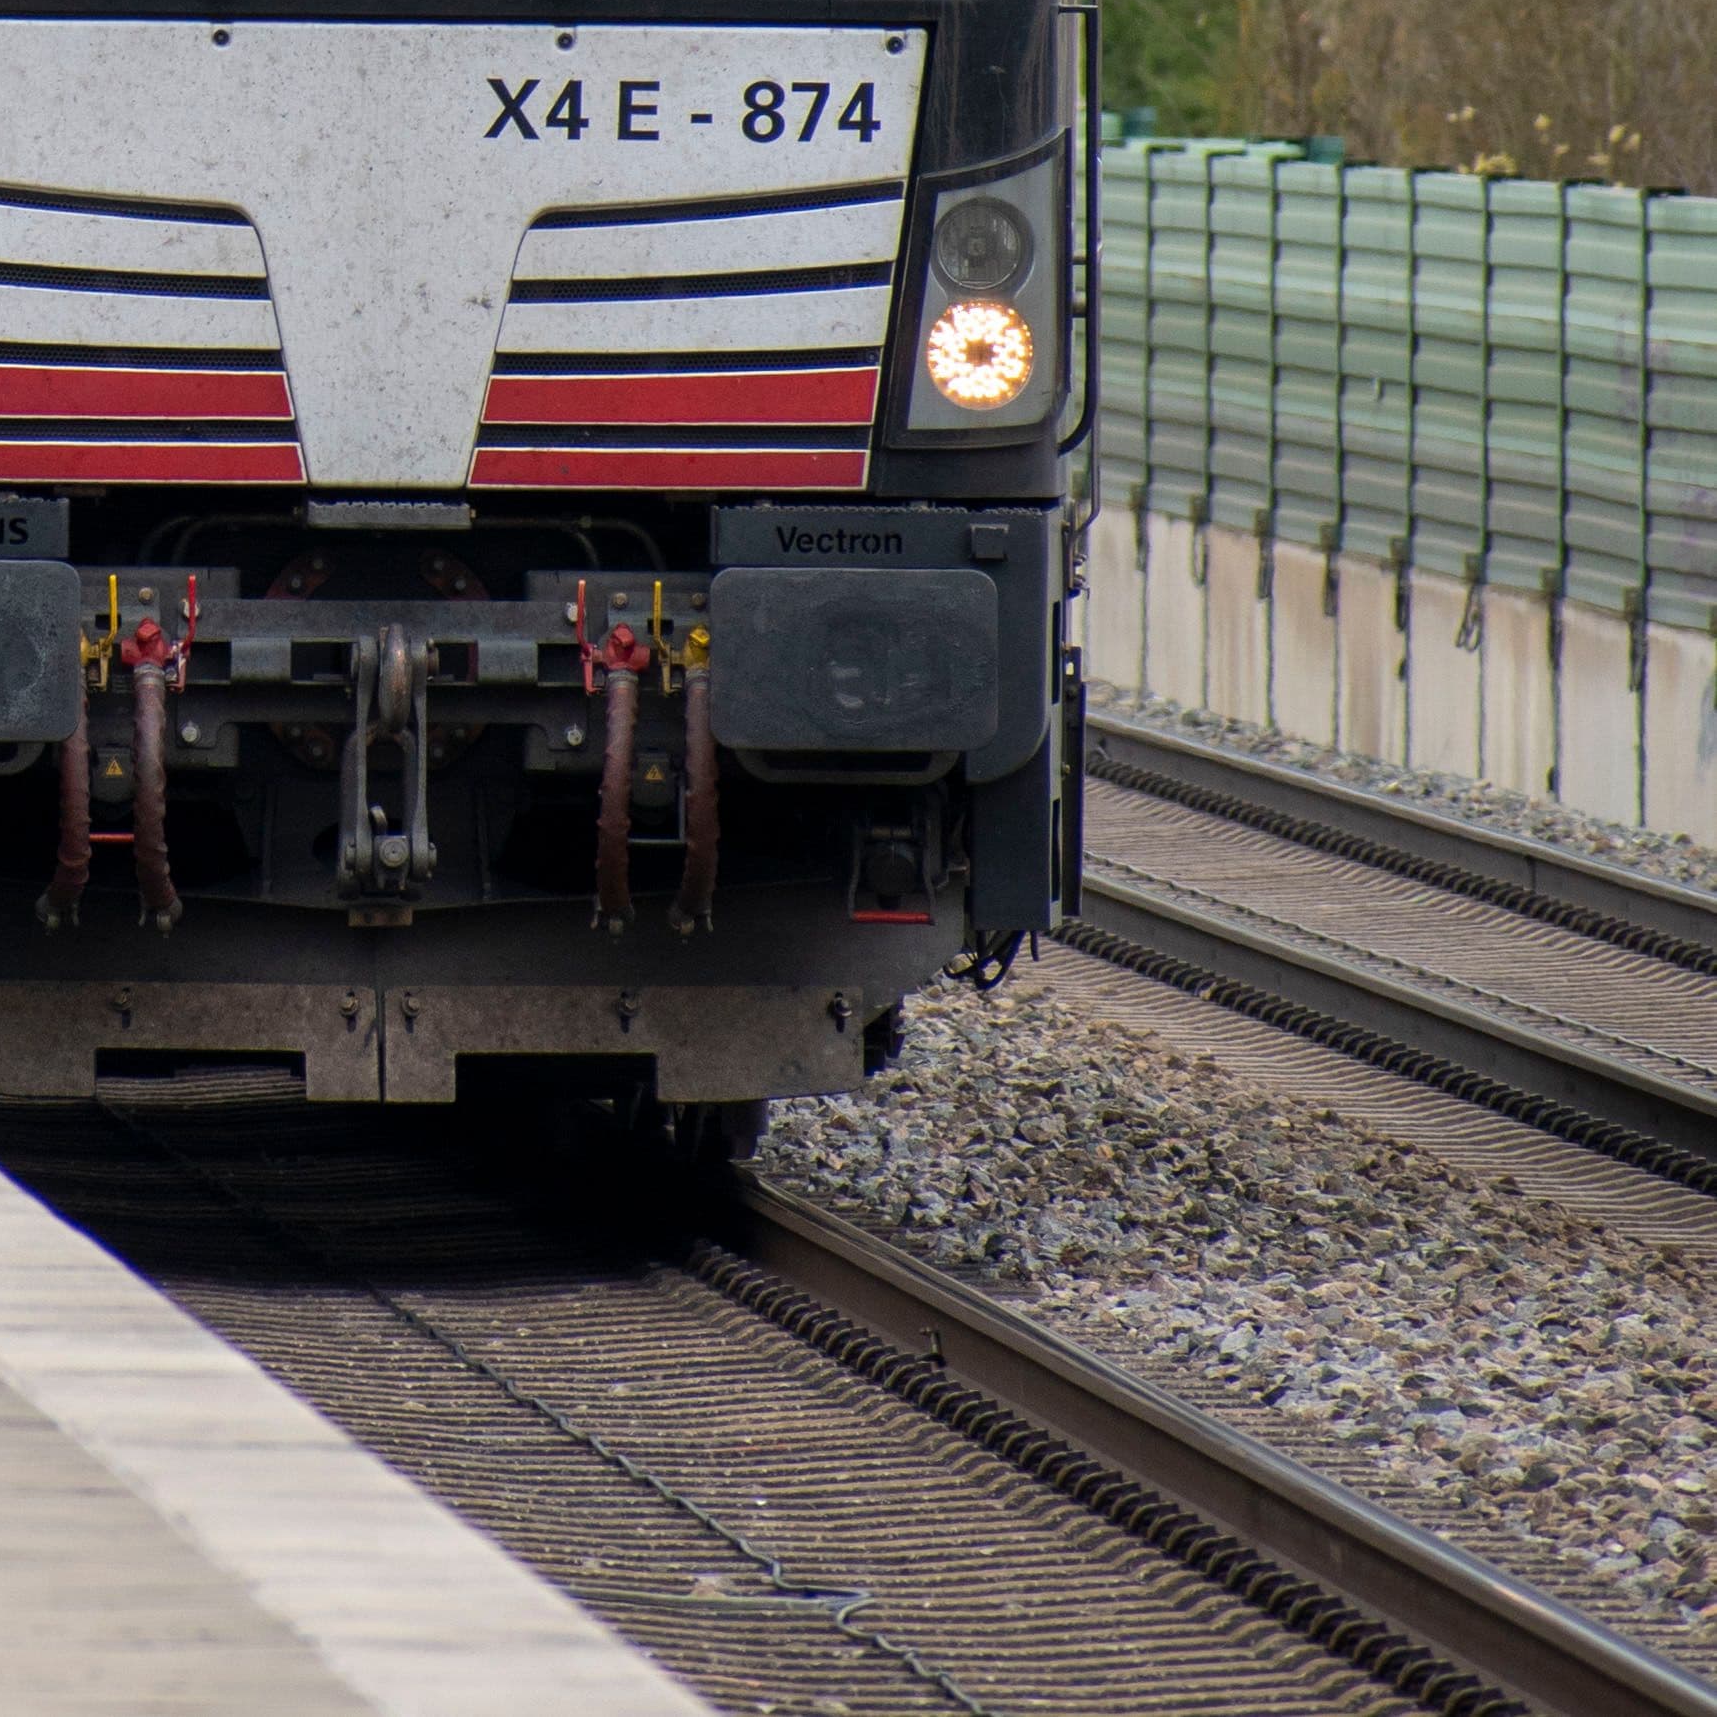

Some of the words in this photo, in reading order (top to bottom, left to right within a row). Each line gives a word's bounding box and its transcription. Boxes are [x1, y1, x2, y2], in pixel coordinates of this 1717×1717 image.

[483, 78, 589, 141] X4
[616, 80, 661, 141] E
[740, 80, 882, 143] 874
[775, 525, 904, 555] Vectron
